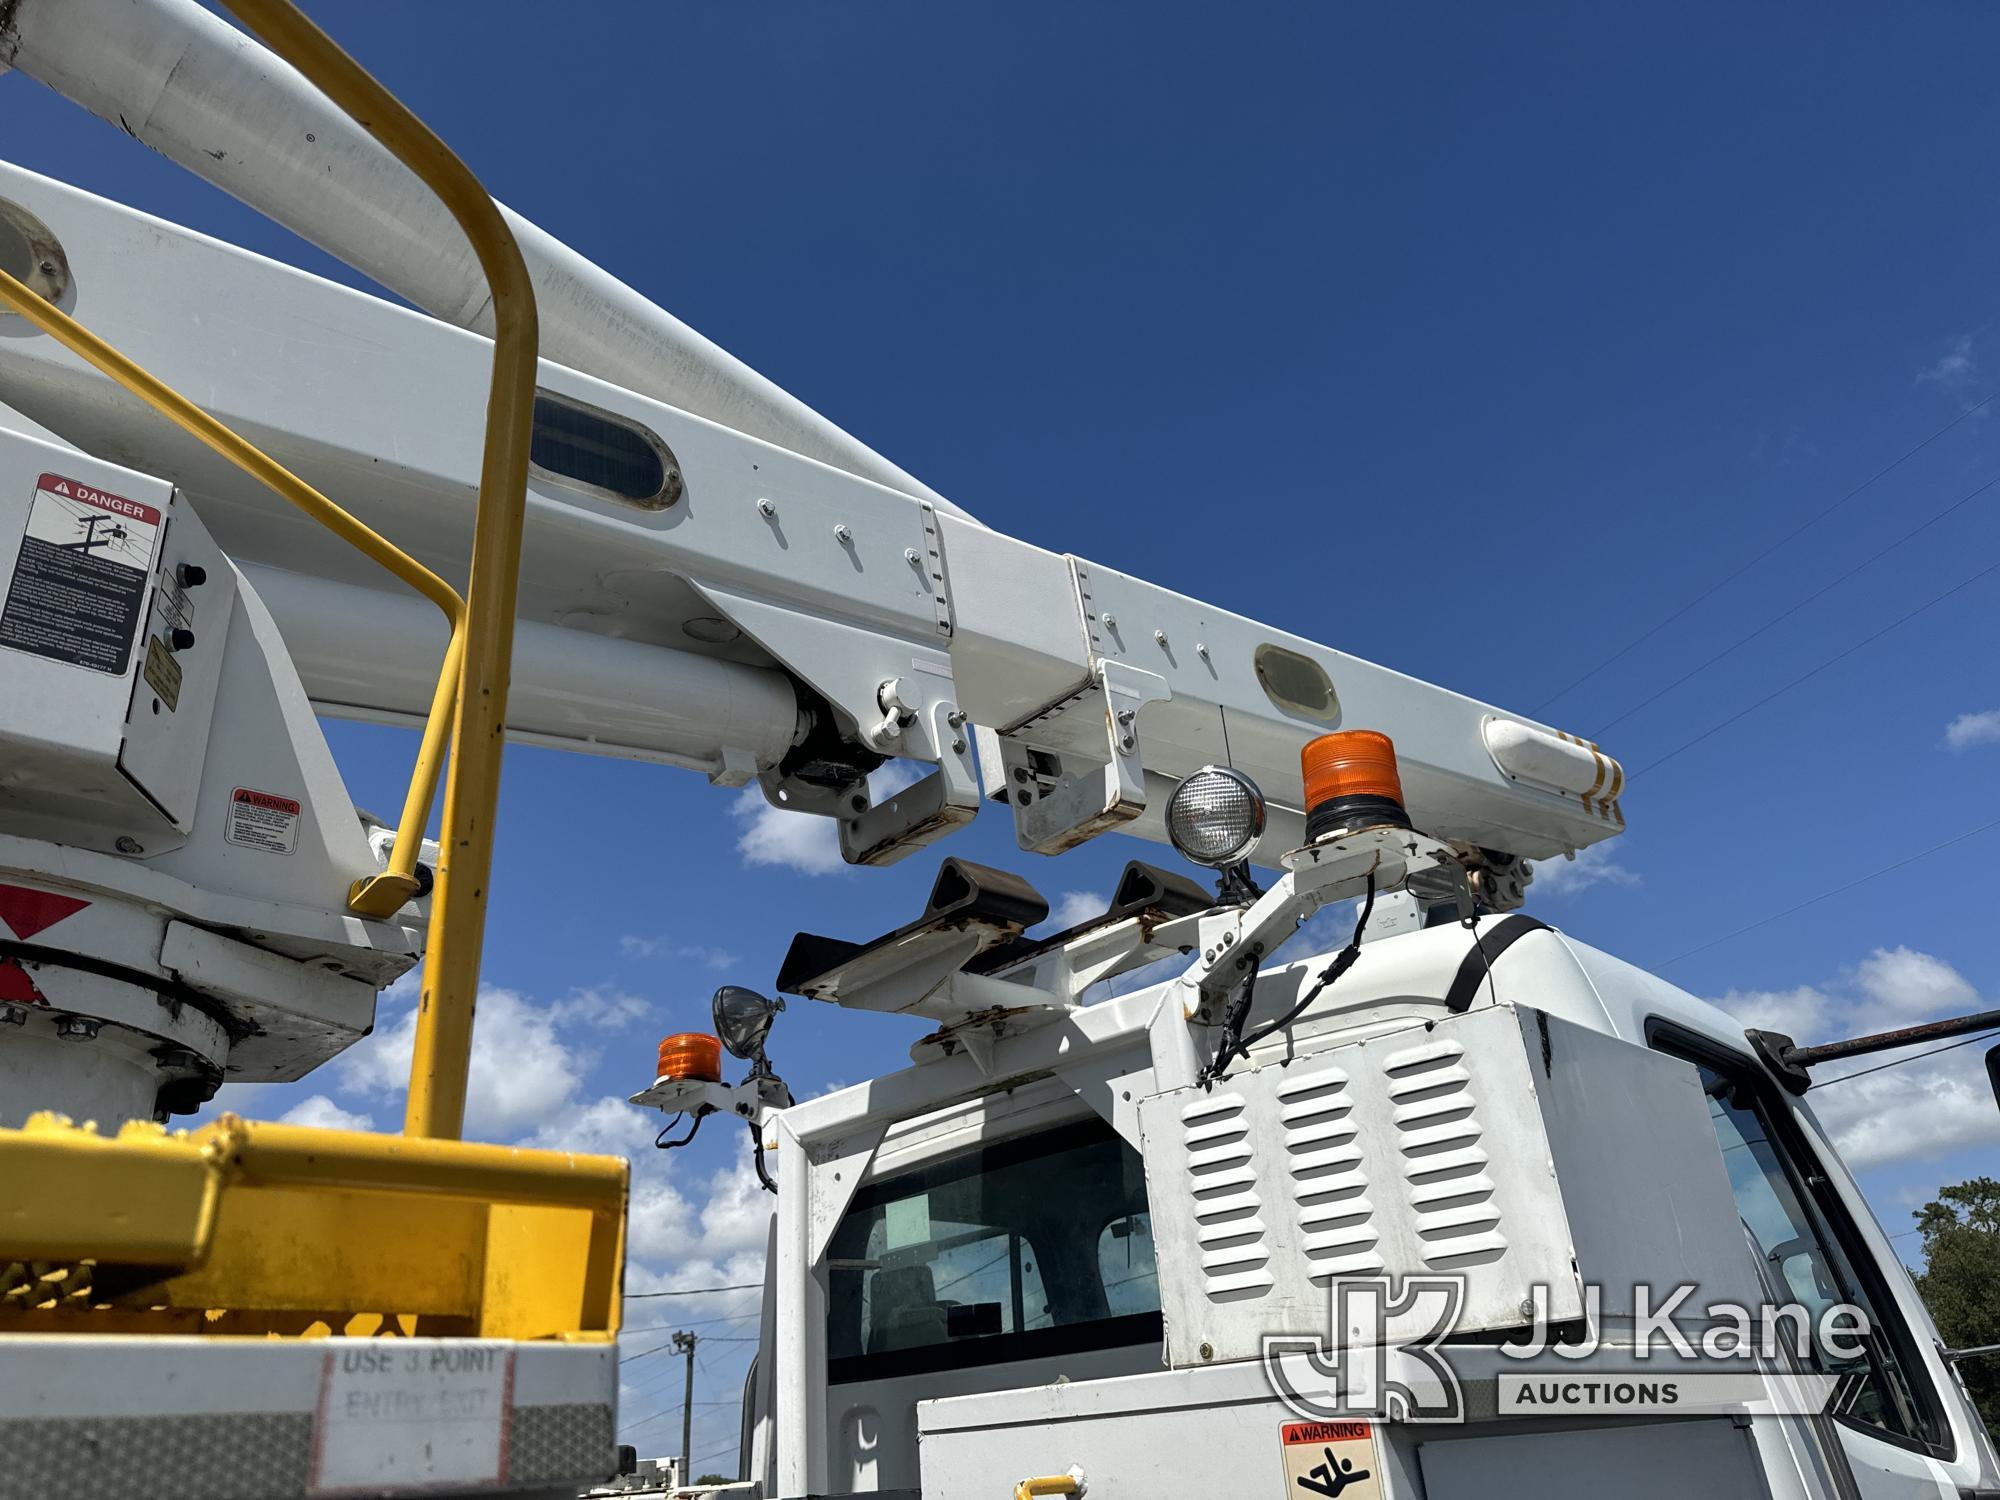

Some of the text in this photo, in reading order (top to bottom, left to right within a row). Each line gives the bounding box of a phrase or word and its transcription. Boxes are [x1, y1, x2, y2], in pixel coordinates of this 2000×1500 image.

[76, 487, 145, 518] DANGER
[253, 794, 295, 812] WARNING
[343, 1348, 496, 1373] USE 3 POINT
[1300, 1422, 1365, 1441] WARNING
